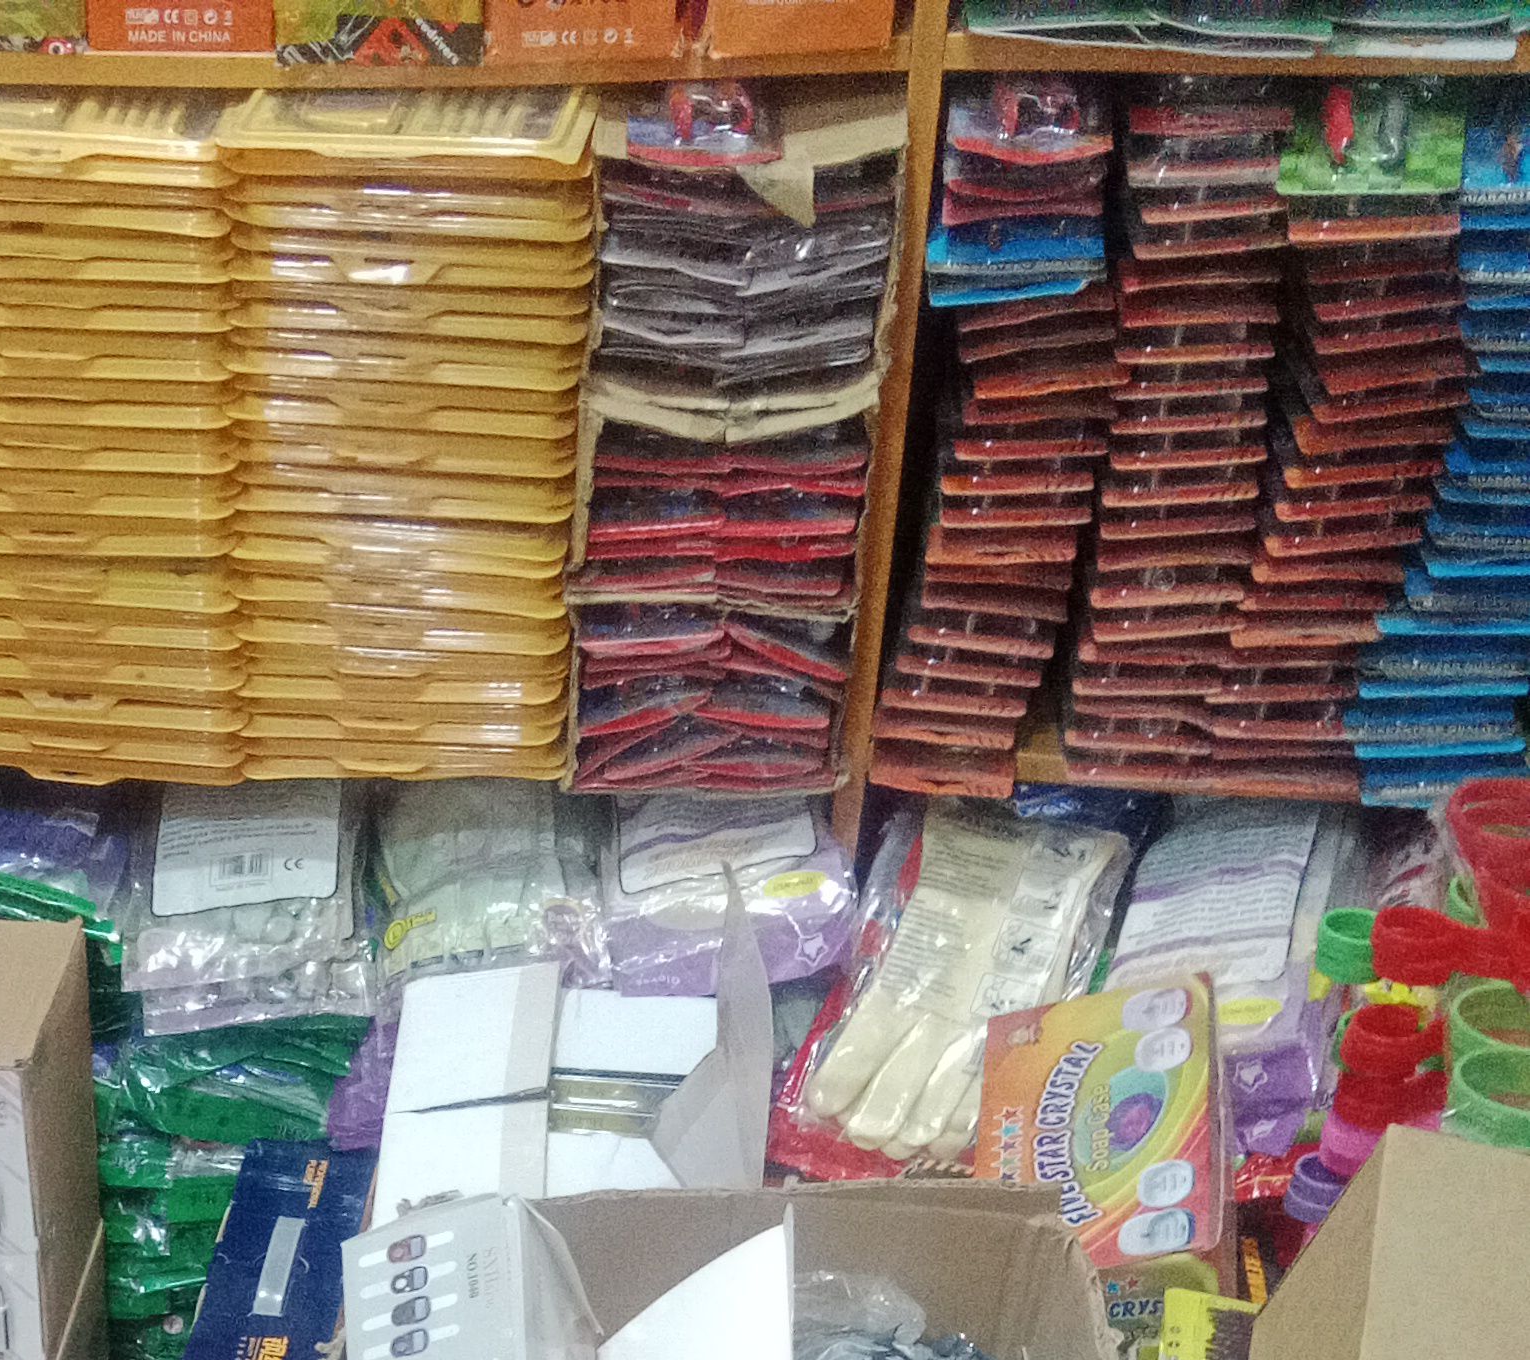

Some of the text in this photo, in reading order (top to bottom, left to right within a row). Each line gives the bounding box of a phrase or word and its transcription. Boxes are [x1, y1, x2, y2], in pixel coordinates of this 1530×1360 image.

[128, 29, 232, 43] MADE IN CHINA
[1036, 1041, 1104, 1130] CRYSTAL
[1033, 1131, 1074, 1182] STAR
[1087, 1083, 1115, 1173] Soap Case
